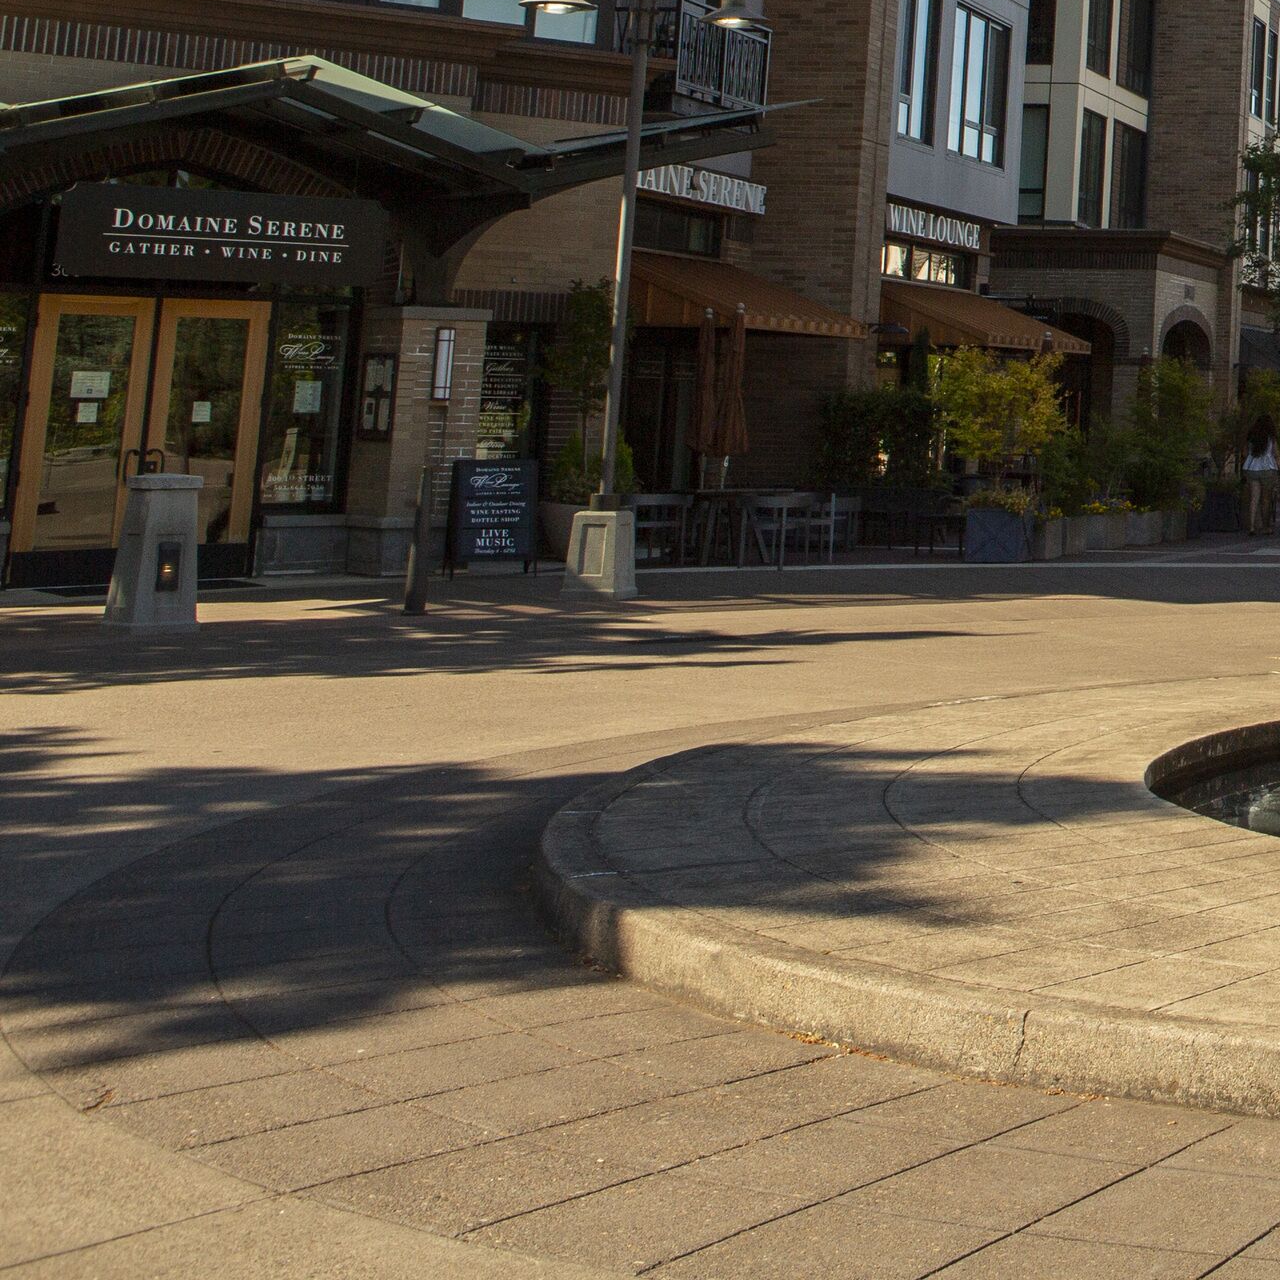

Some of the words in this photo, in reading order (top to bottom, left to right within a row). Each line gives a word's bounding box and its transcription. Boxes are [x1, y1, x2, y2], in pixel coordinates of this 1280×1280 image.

[698, 170, 767, 216] SERENE
[112, 207, 238, 234] DOMAINE
[247, 215, 345, 240] SERENE
[889, 203, 926, 238] WINE
[928, 213, 981, 250] LOUNGE
[108, 241, 195, 257] GATHER
[220, 246, 273, 260] WINE
[295, 250, 343, 264] DINE
[297, 474, 332, 482] STREET
[475, 538, 515, 547] MUSIC
[481, 528, 509, 538] LIVE
